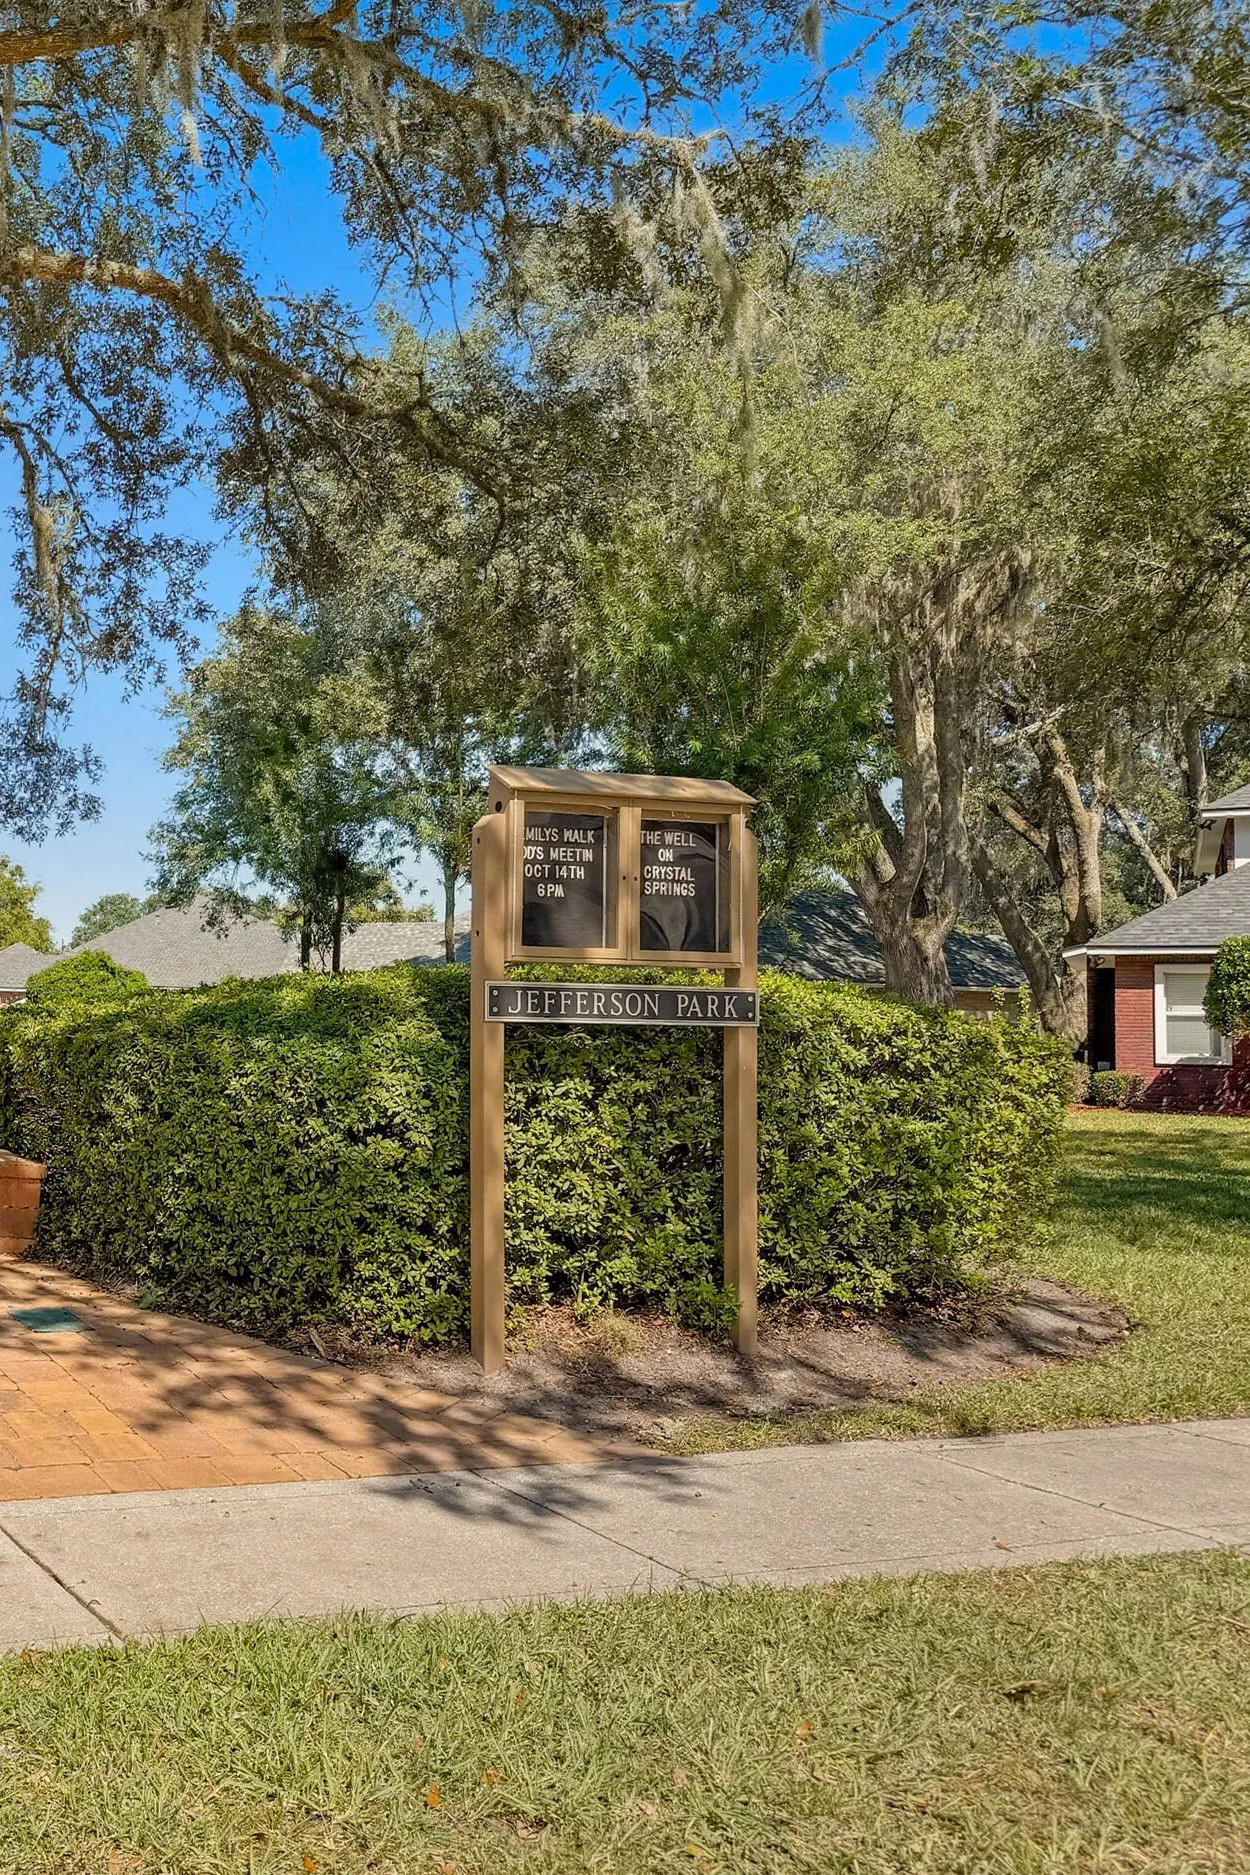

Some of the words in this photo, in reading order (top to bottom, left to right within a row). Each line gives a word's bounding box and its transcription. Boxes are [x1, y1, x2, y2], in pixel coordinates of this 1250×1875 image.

[523, 826, 559, 842] MILYS
[563, 828, 595, 844] WALK
[640, 830, 662, 845] THE
[664, 831, 697, 847] WELL
[549, 847, 593, 862] MEETIN
[658, 848, 674, 862] ON
[524, 863, 551, 878] OCT
[555, 865, 585, 880] 14TH
[643, 865, 695, 881] CRYSTAL
[537, 883, 565, 898] 6PM
[644, 881, 696, 897] SPRINGS
[508, 989, 660, 1017] JEFFERSON
[676, 993, 739, 1018] PARK
